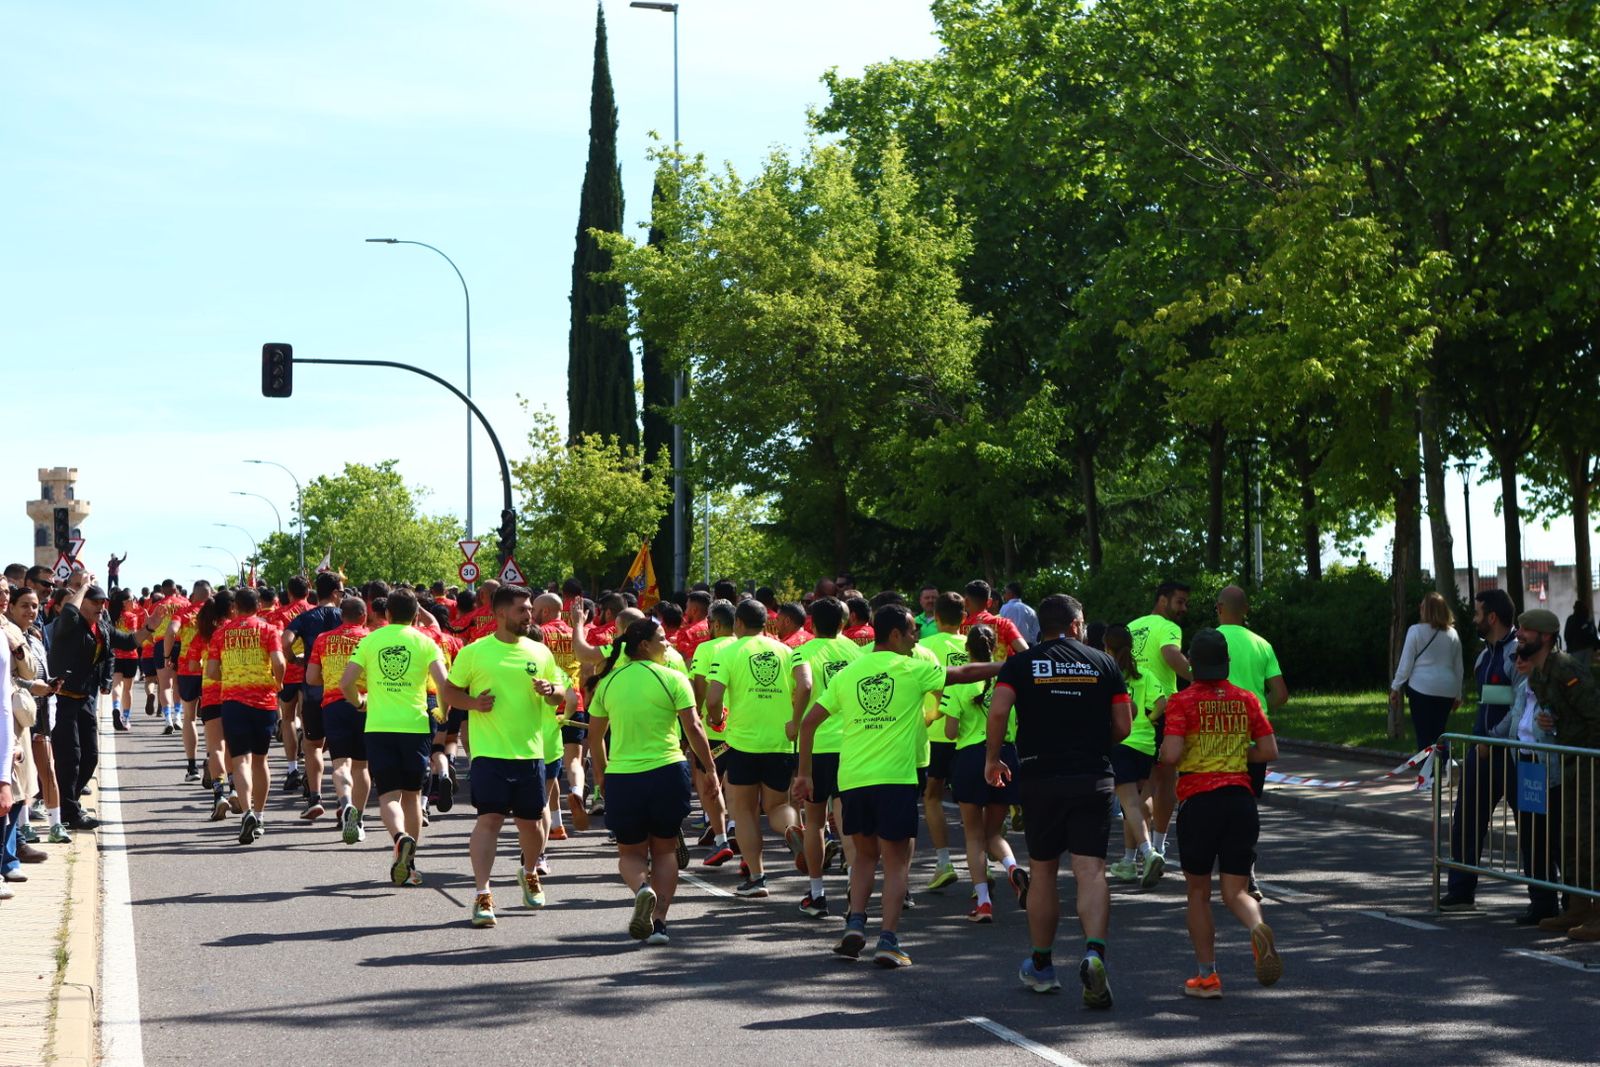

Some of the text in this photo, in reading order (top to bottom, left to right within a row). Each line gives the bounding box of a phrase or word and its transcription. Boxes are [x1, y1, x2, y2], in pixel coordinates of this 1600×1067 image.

[1069, 669, 1100, 677] BLANCO
[1199, 700, 1247, 714] FORTALEZA
[1199, 714, 1248, 733] LEALTAD
